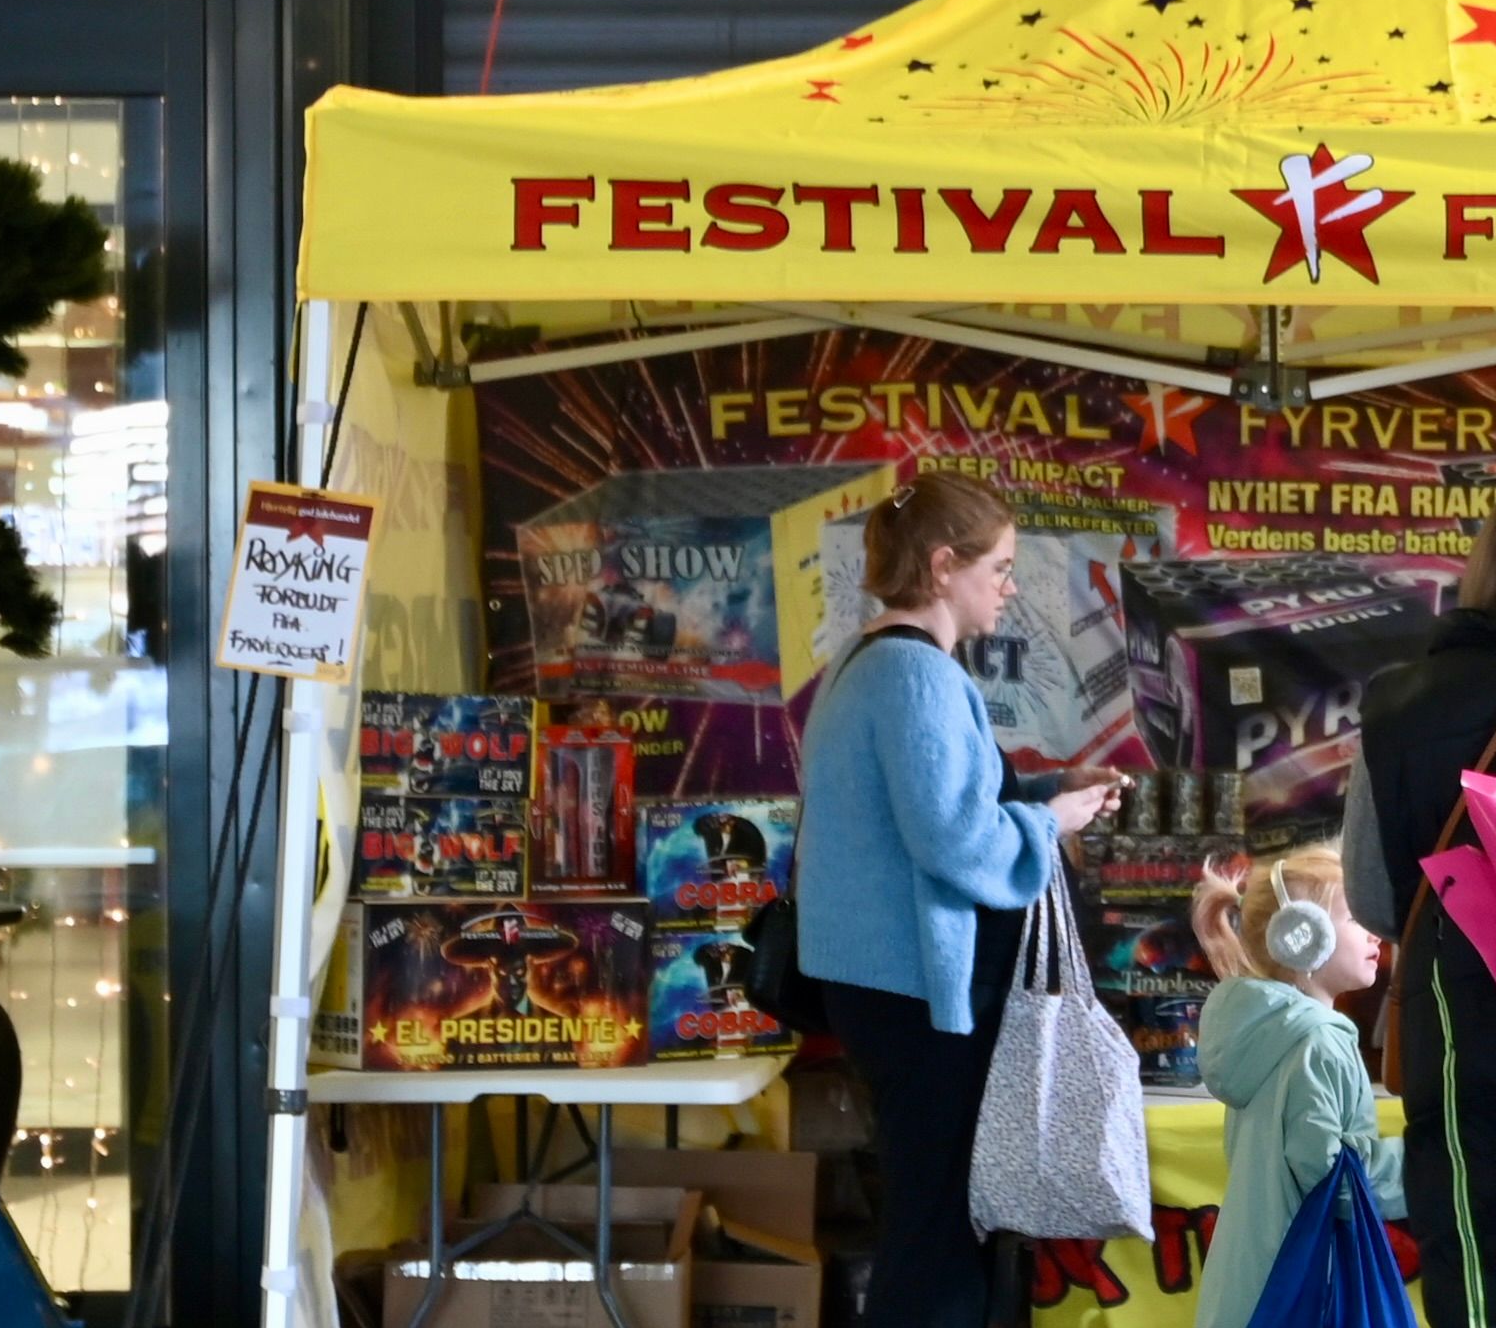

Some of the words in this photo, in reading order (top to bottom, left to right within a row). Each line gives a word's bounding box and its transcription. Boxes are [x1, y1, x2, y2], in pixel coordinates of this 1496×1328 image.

[510, 176, 1226, 257] FESTIVAL
[709, 382, 1111, 440] FESTIVAL
[1010, 457, 1126, 488] IMPACT
[1207, 480, 1320, 515] NYHET
[1331, 483, 1399, 516] FRA
[1207, 524, 1315, 553] Verdens
[1324, 525, 1396, 554] beste
[1405, 526, 1476, 556] batte
[620, 544, 745, 583] SHOW
[1236, 678, 1364, 772] PYR
[359, 727, 415, 758] BIG
[439, 731, 529, 761] WOLF
[362, 832, 416, 861] BIG
[439, 833, 522, 862] WOLF
[674, 880, 779, 911] COBRA
[396, 1021, 430, 1046] EL
[440, 1018, 618, 1045] PRESIDENTE
[675, 1009, 781, 1040] COBRA
